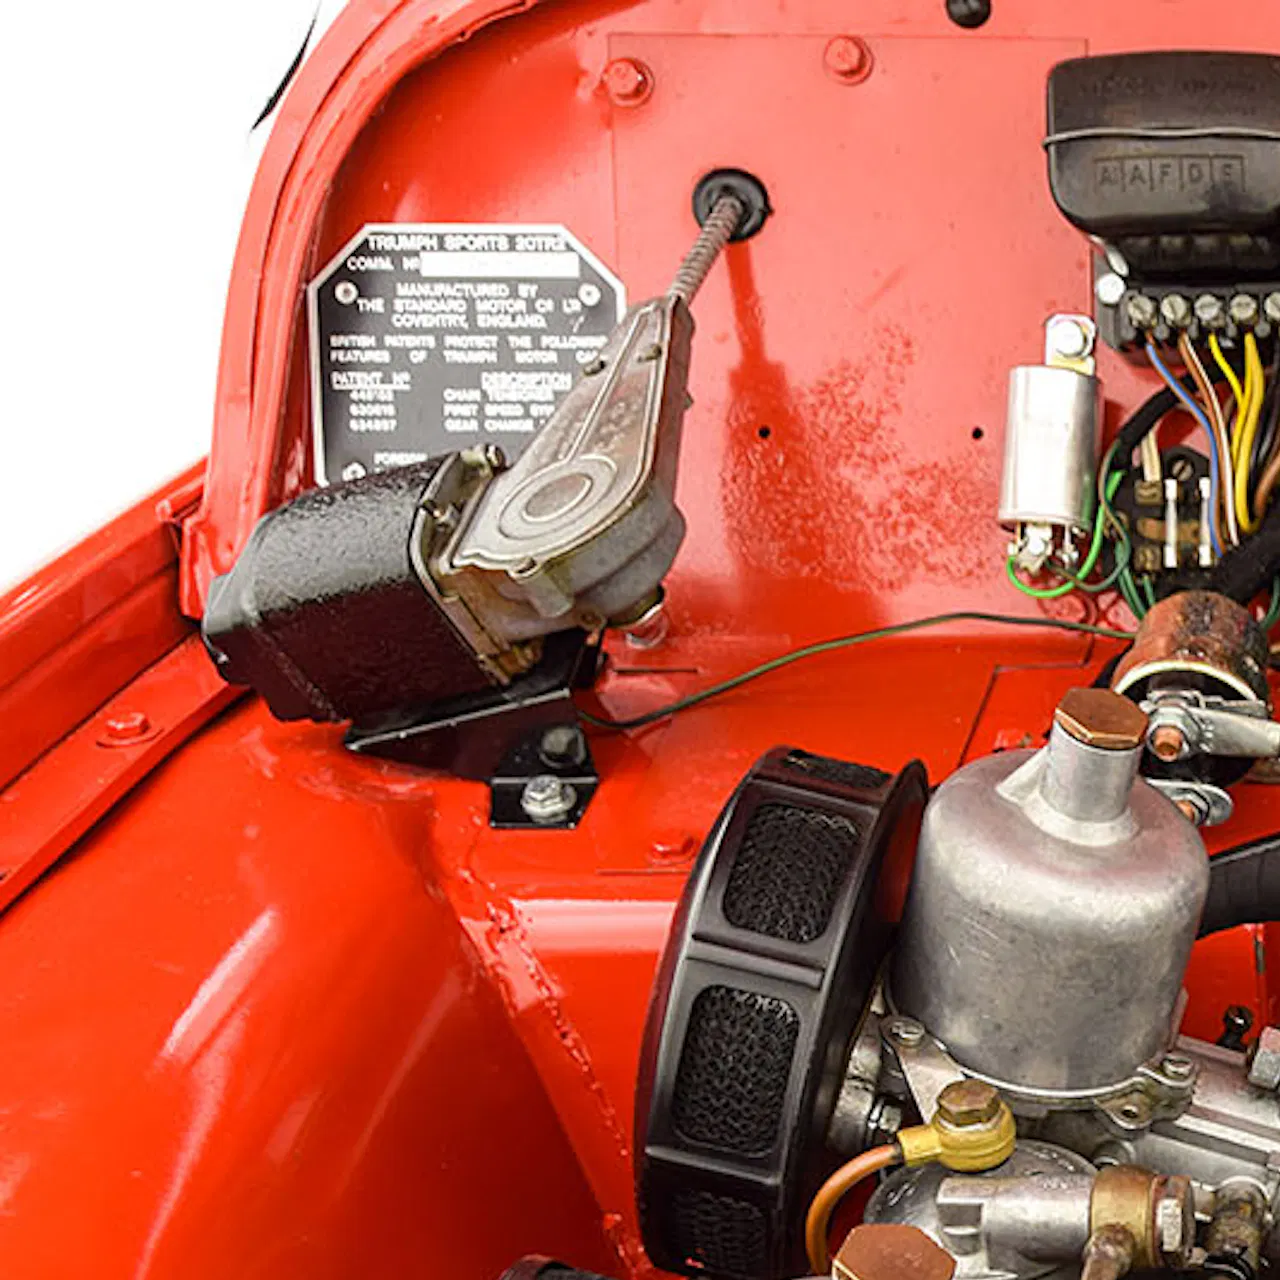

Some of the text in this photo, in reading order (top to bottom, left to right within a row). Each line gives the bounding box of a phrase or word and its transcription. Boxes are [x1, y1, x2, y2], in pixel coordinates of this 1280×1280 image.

[368, 233, 438, 251] TRIUMPH
[443, 233, 509, 251] SPORTS
[396, 282, 539, 299] MANUFACTURED BY
[357, 297, 385, 313] THE
[392, 297, 467, 314] STANDARD
[475, 297, 527, 314] MOTOR
[383, 334, 436, 350] PATENTS
[444, 334, 499, 349] PROTECT
[507, 334, 533, 349] THE
[329, 348, 391, 364] FEATURES
[409, 349, 428, 364] OF
[442, 349, 498, 364] TRIUMPH
[515, 349, 558, 364] MOTOR
[331, 371, 382, 386] PATENT
[481, 371, 573, 388] DESCRIPTION
[443, 418, 480, 433] GEAR
